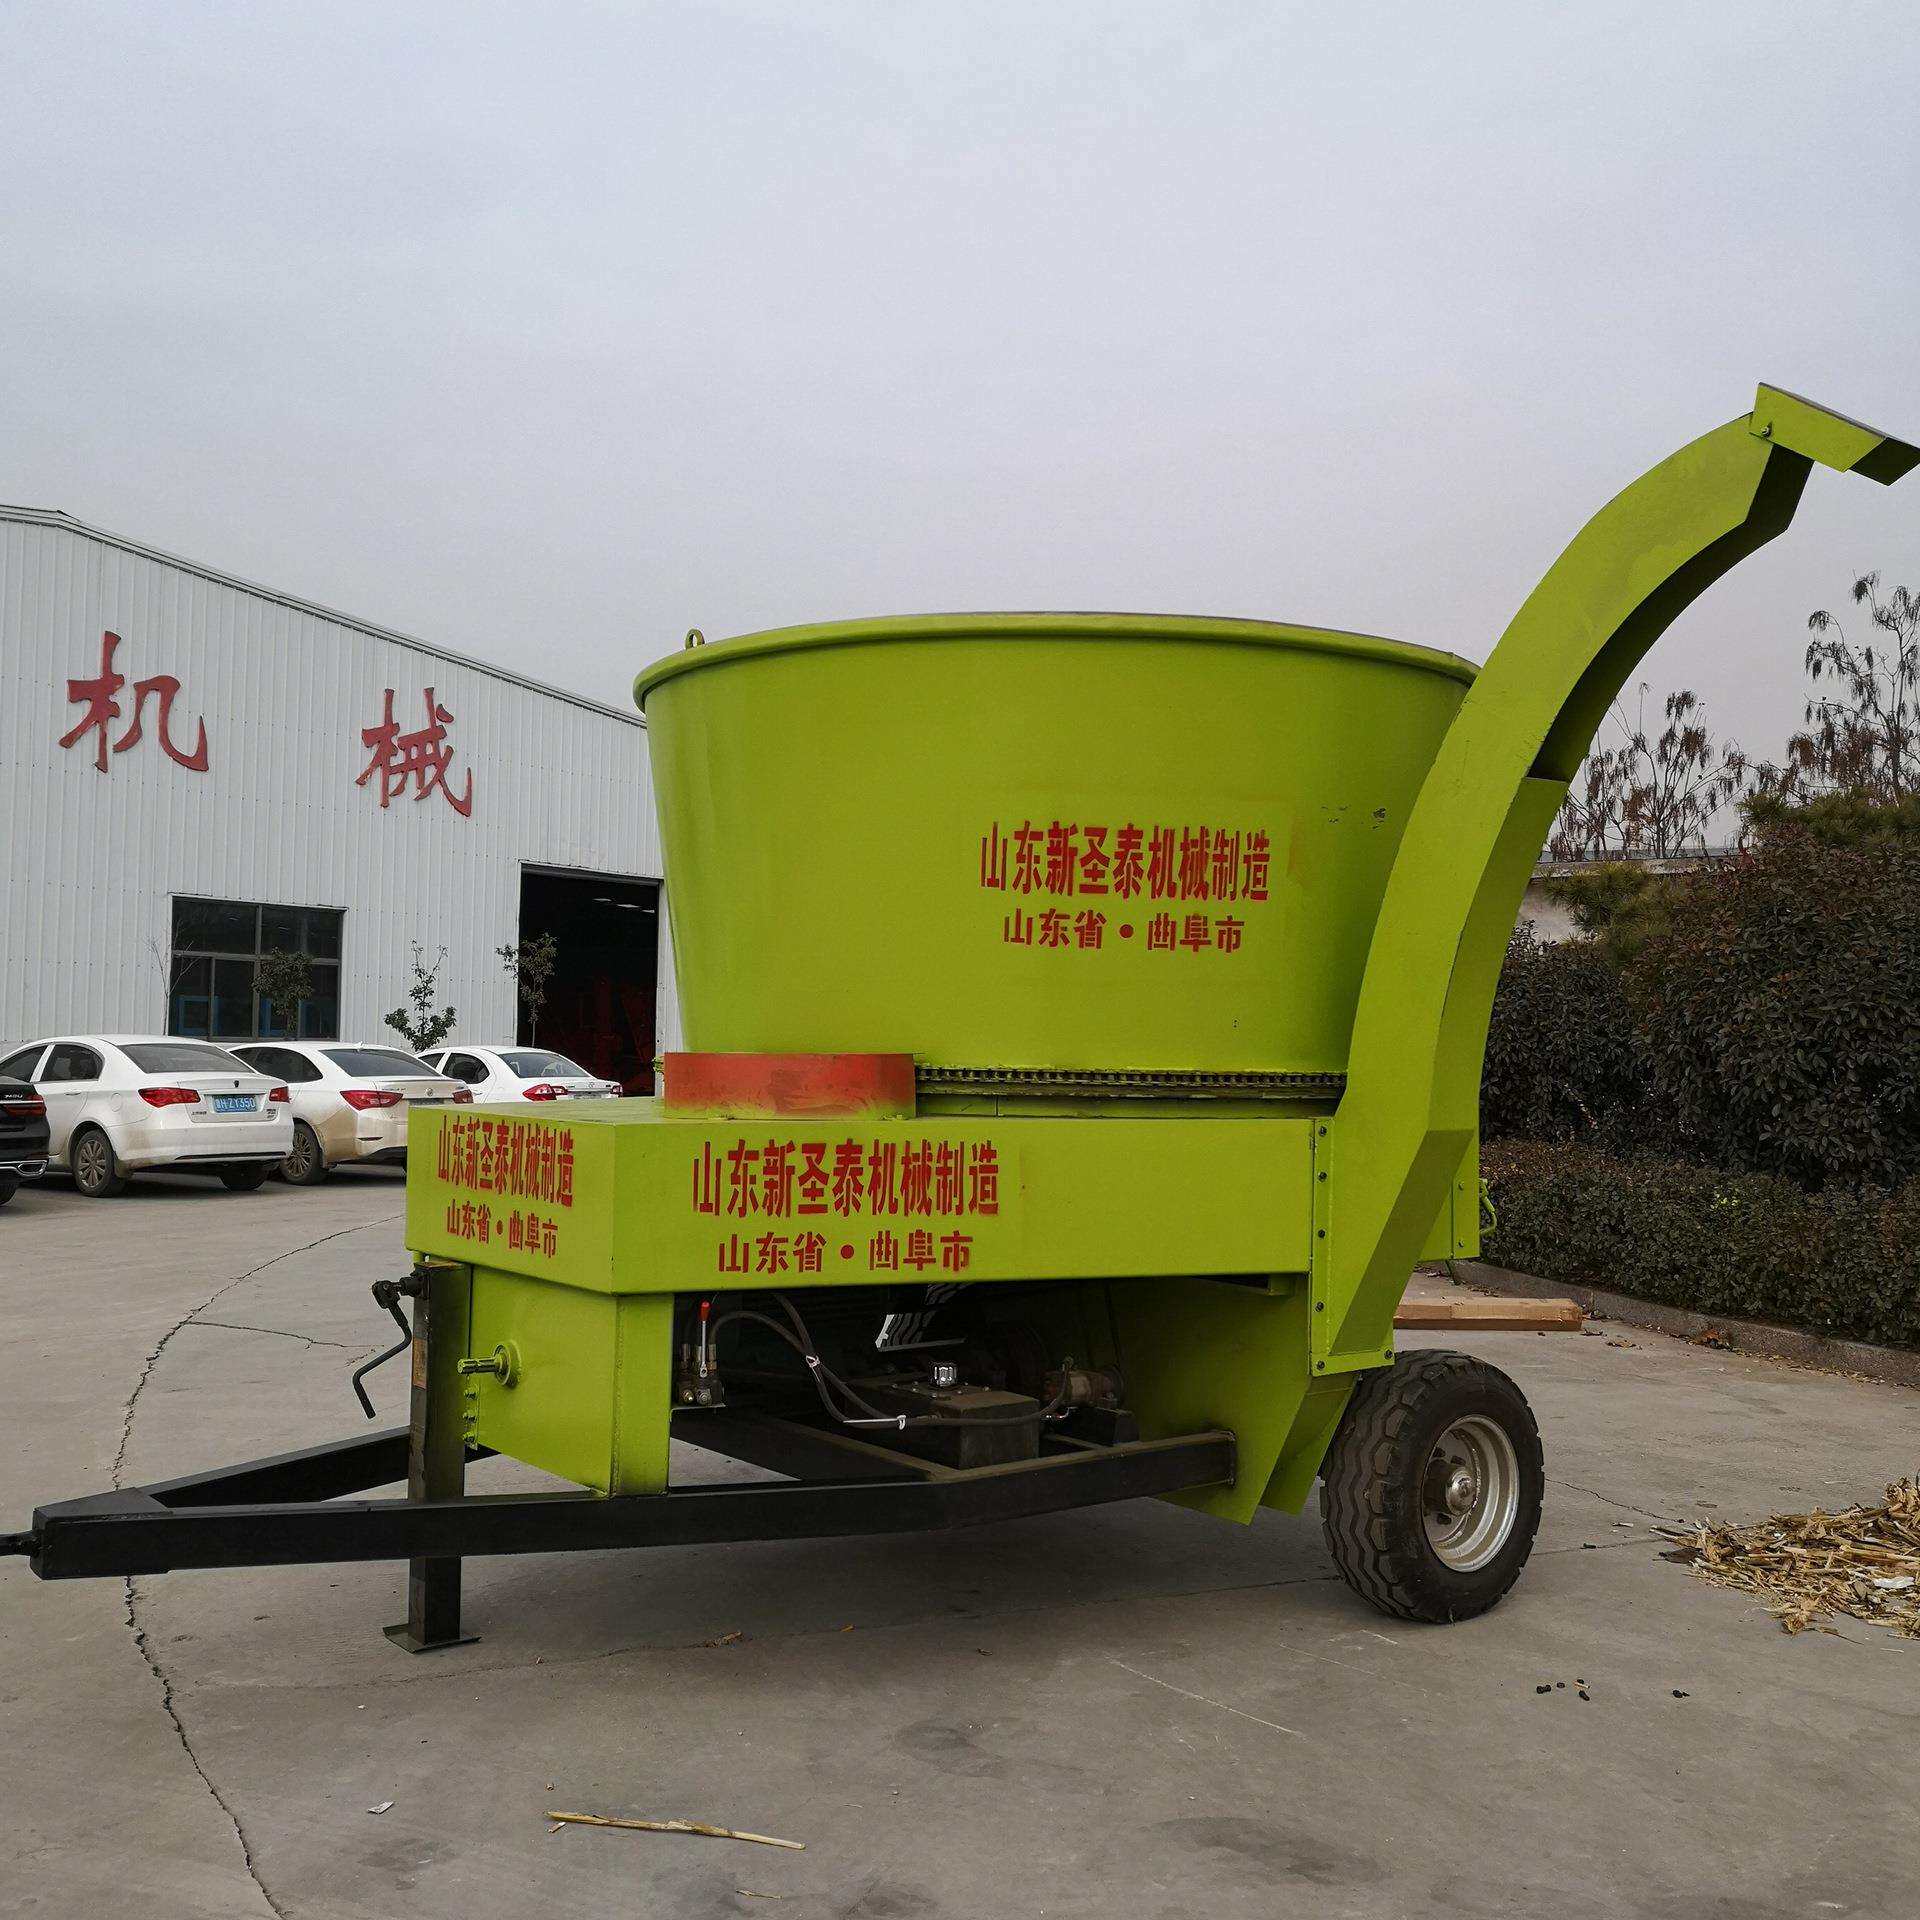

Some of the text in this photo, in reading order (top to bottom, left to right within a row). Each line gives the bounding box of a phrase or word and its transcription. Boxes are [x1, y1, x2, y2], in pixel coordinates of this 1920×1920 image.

[58, 630, 472, 818] 机 械
[980, 820, 1270, 901] 山东新圣泰机械制造
[1004, 907, 1245, 953] 山东省·曲阜市
[438, 1114, 573, 1208] 山东新圣泰机械制造
[693, 1138, 999, 1217] 山东新圣泰机械制造
[718, 1229, 973, 1274] 山东省·曲阜市
